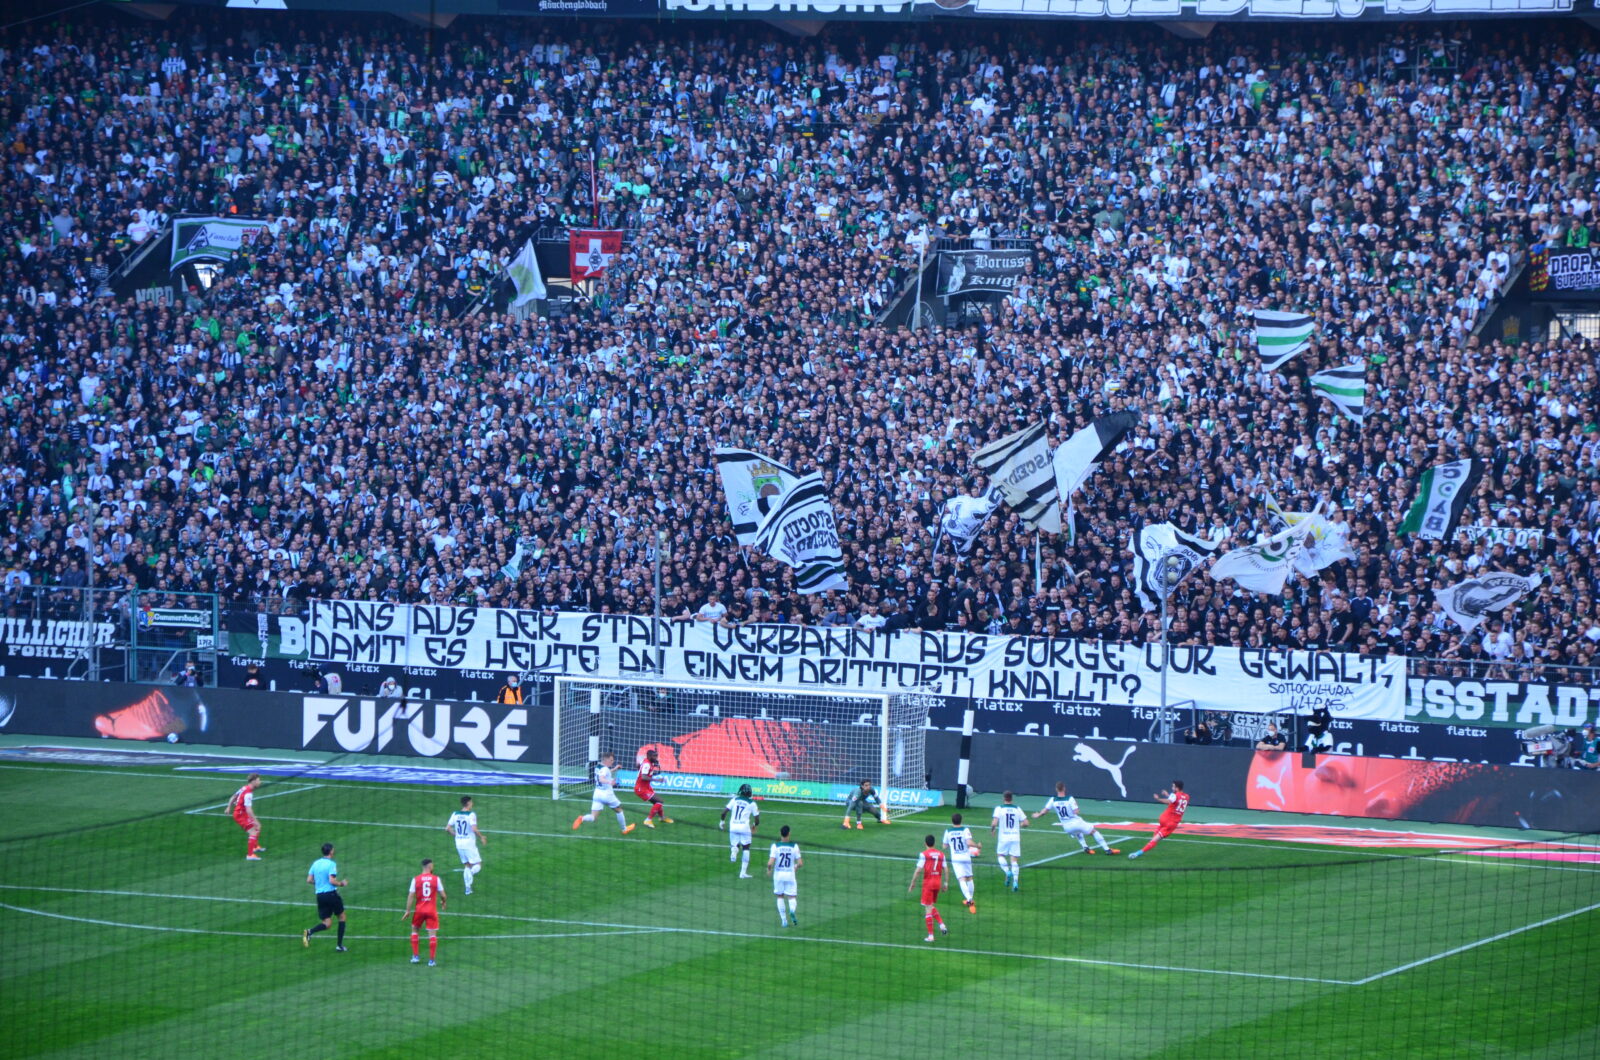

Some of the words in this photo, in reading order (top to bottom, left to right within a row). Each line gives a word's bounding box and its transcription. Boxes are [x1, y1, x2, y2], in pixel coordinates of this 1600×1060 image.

[310, 600, 395, 632] FANS
[413, 605, 478, 636] AUS
[497, 610, 560, 641] DER
[582, 614, 694, 648] STADT
[713, 623, 900, 659] VERBANNT
[920, 632, 988, 665] AUS
[1004, 635, 1125, 671] SORGE
[1240, 648, 1393, 688] GEWALT,
[310, 629, 405, 663] DAMIT
[425, 637, 467, 666] ES
[485, 640, 600, 673] HEUTE
[684, 650, 784, 683] EINEM
[800, 657, 968, 694] DRITTORT
[988, 670, 1142, 703] KNALLT?
[345, 662, 380, 673] flatex
[402, 666, 437, 677] flatex
[460, 669, 495, 680] flatex
[518, 673, 552, 683] flatex
[975, 698, 1023, 712] flatex
[1052, 702, 1101, 717] flatex
[302, 697, 529, 760] FUTURE
[1379, 721, 1420, 733] flatex
[1446, 725, 1487, 737] flatex
[734, 805, 745, 820] 17
[1175, 799, 1188, 813] 13
[456, 820, 468, 836] 32
[1005, 813, 1016, 829] 15
[778, 852, 792, 868] 25
[932, 855, 939, 871] 7
[422, 881, 431, 897] 6
